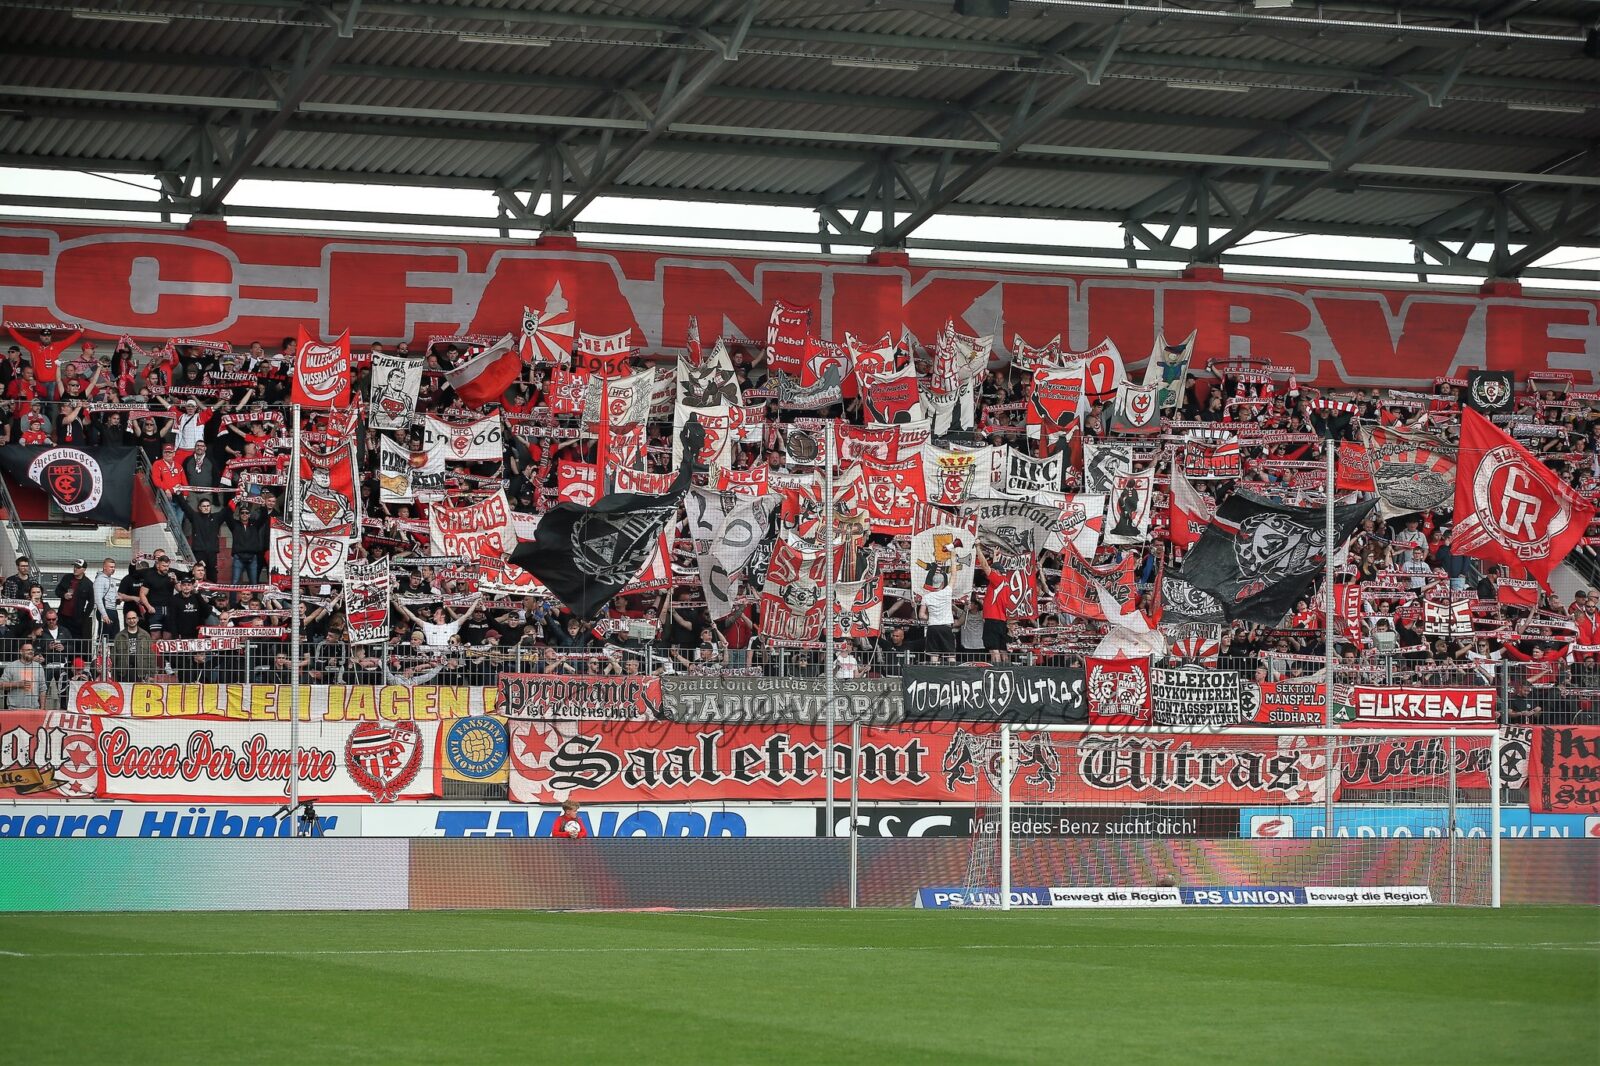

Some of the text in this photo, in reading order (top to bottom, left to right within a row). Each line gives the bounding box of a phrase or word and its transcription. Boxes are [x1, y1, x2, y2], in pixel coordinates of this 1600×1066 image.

[305, 346, 341, 368] HALLESCHER
[372, 355, 405, 369] CHEMIE
[766, 346, 800, 365] Stadion
[168, 386, 205, 395] HALLESCHER
[612, 389, 630, 397] HFC
[453, 428, 469, 436] HFC
[34, 448, 94, 469] Merseburger
[1010, 456, 1058, 482] HFC
[1117, 477, 1142, 489] HC
[1058, 502, 1079, 511] HFC
[436, 495, 508, 534] CHEMIE
[999, 527, 1015, 535] HFC
[316, 540, 336, 549] HFC
[758, 677, 807, 692] Ultras
[1153, 671, 1238, 687] TELEKOM
[987, 671, 1011, 706] 19
[1014, 679, 1083, 709] ULTRAS
[1153, 685, 1238, 700] BOYKOTTIEREN
[1275, 683, 1316, 693] SEKTION
[131, 683, 470, 721] BULLEN JAGEN
[500, 677, 640, 717] Pyromanie
[1265, 694, 1326, 706] MANSFELD
[526, 701, 639, 718] ist Leidenschaft
[661, 691, 905, 722] STADIONVERBOT
[1153, 700, 1239, 714] MONTAGSSPIELE
[1358, 693, 1493, 718] SURREALE
[1179, 714, 1239, 726] AKZEPTIEREN
[1269, 708, 1321, 723] SÜDHARZ
[388, 729, 411, 742] HFC
[456, 719, 505, 745] FANSZENE
[102, 727, 336, 796] Coesa Per Sempre
[450, 740, 504, 774] LOKOMOTIVE
[550, 730, 929, 791] Saalefront
[1077, 733, 1303, 792] Ultras
[1342, 735, 1494, 784] Köthen
[968, 817, 1197, 835] Meredes-Benz sucht dich!
[934, 892, 1038, 906] PS UNON
[1054, 891, 1177, 903] bewegt die Region
[1194, 890, 1294, 905] PS UNION
[1310, 891, 1429, 904] bewegt die Region
